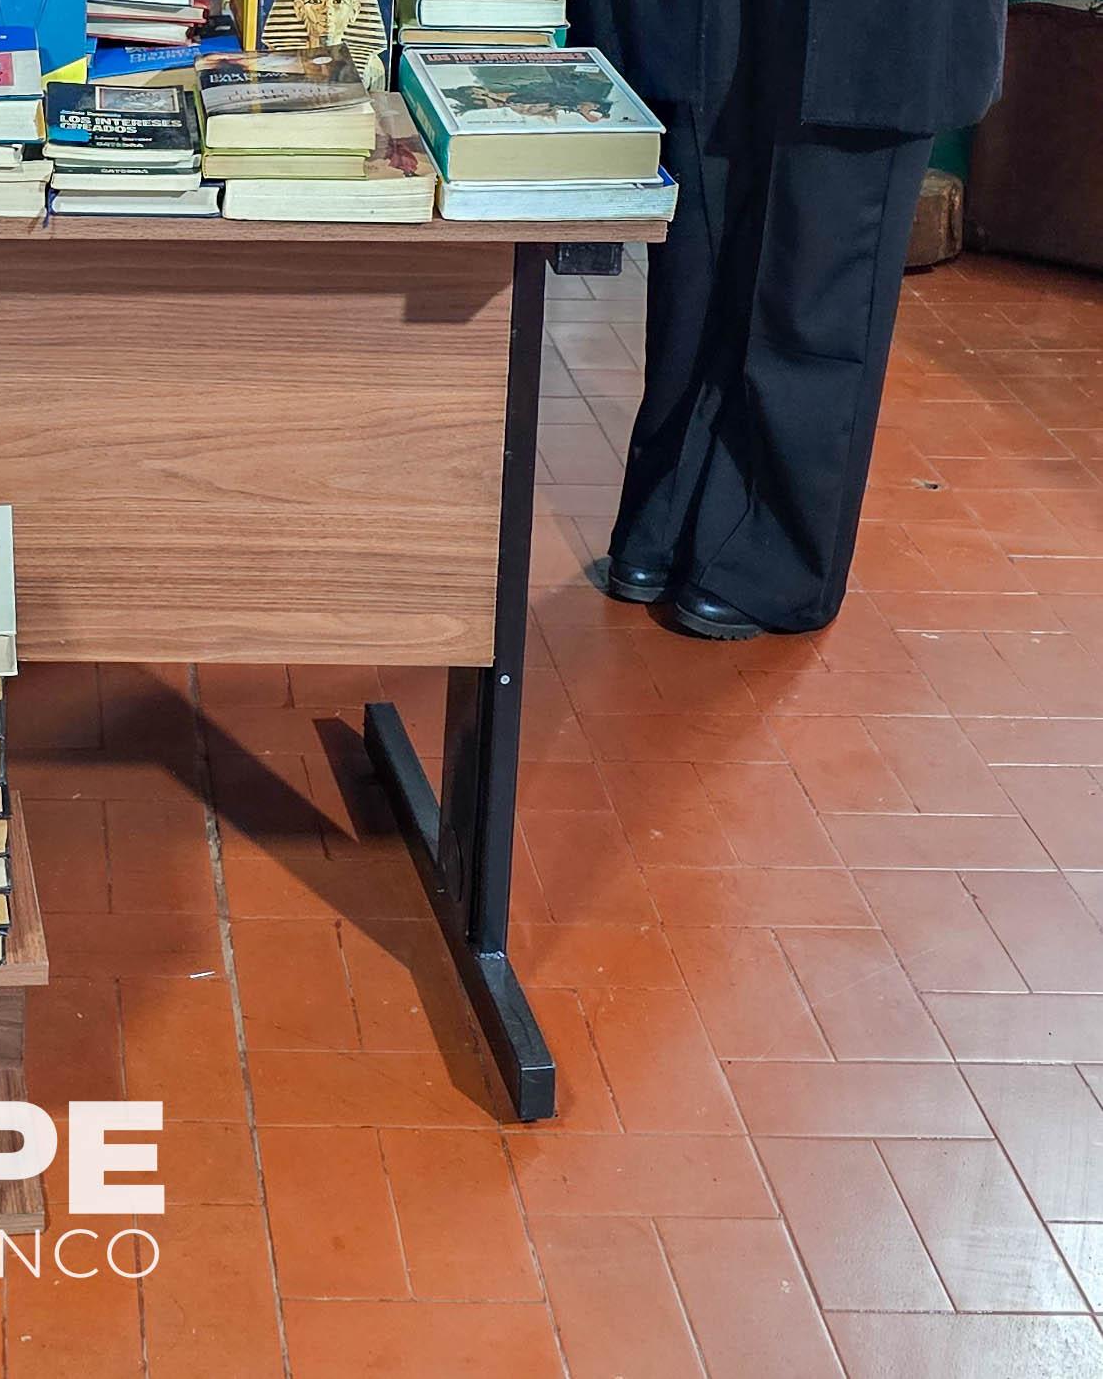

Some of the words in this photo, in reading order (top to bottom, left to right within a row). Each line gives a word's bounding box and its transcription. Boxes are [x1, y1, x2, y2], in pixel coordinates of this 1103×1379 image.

[59, 115, 91, 124] LOS
[95, 117, 183, 128] INTERESES
[59, 122, 138, 134] CREADOS
